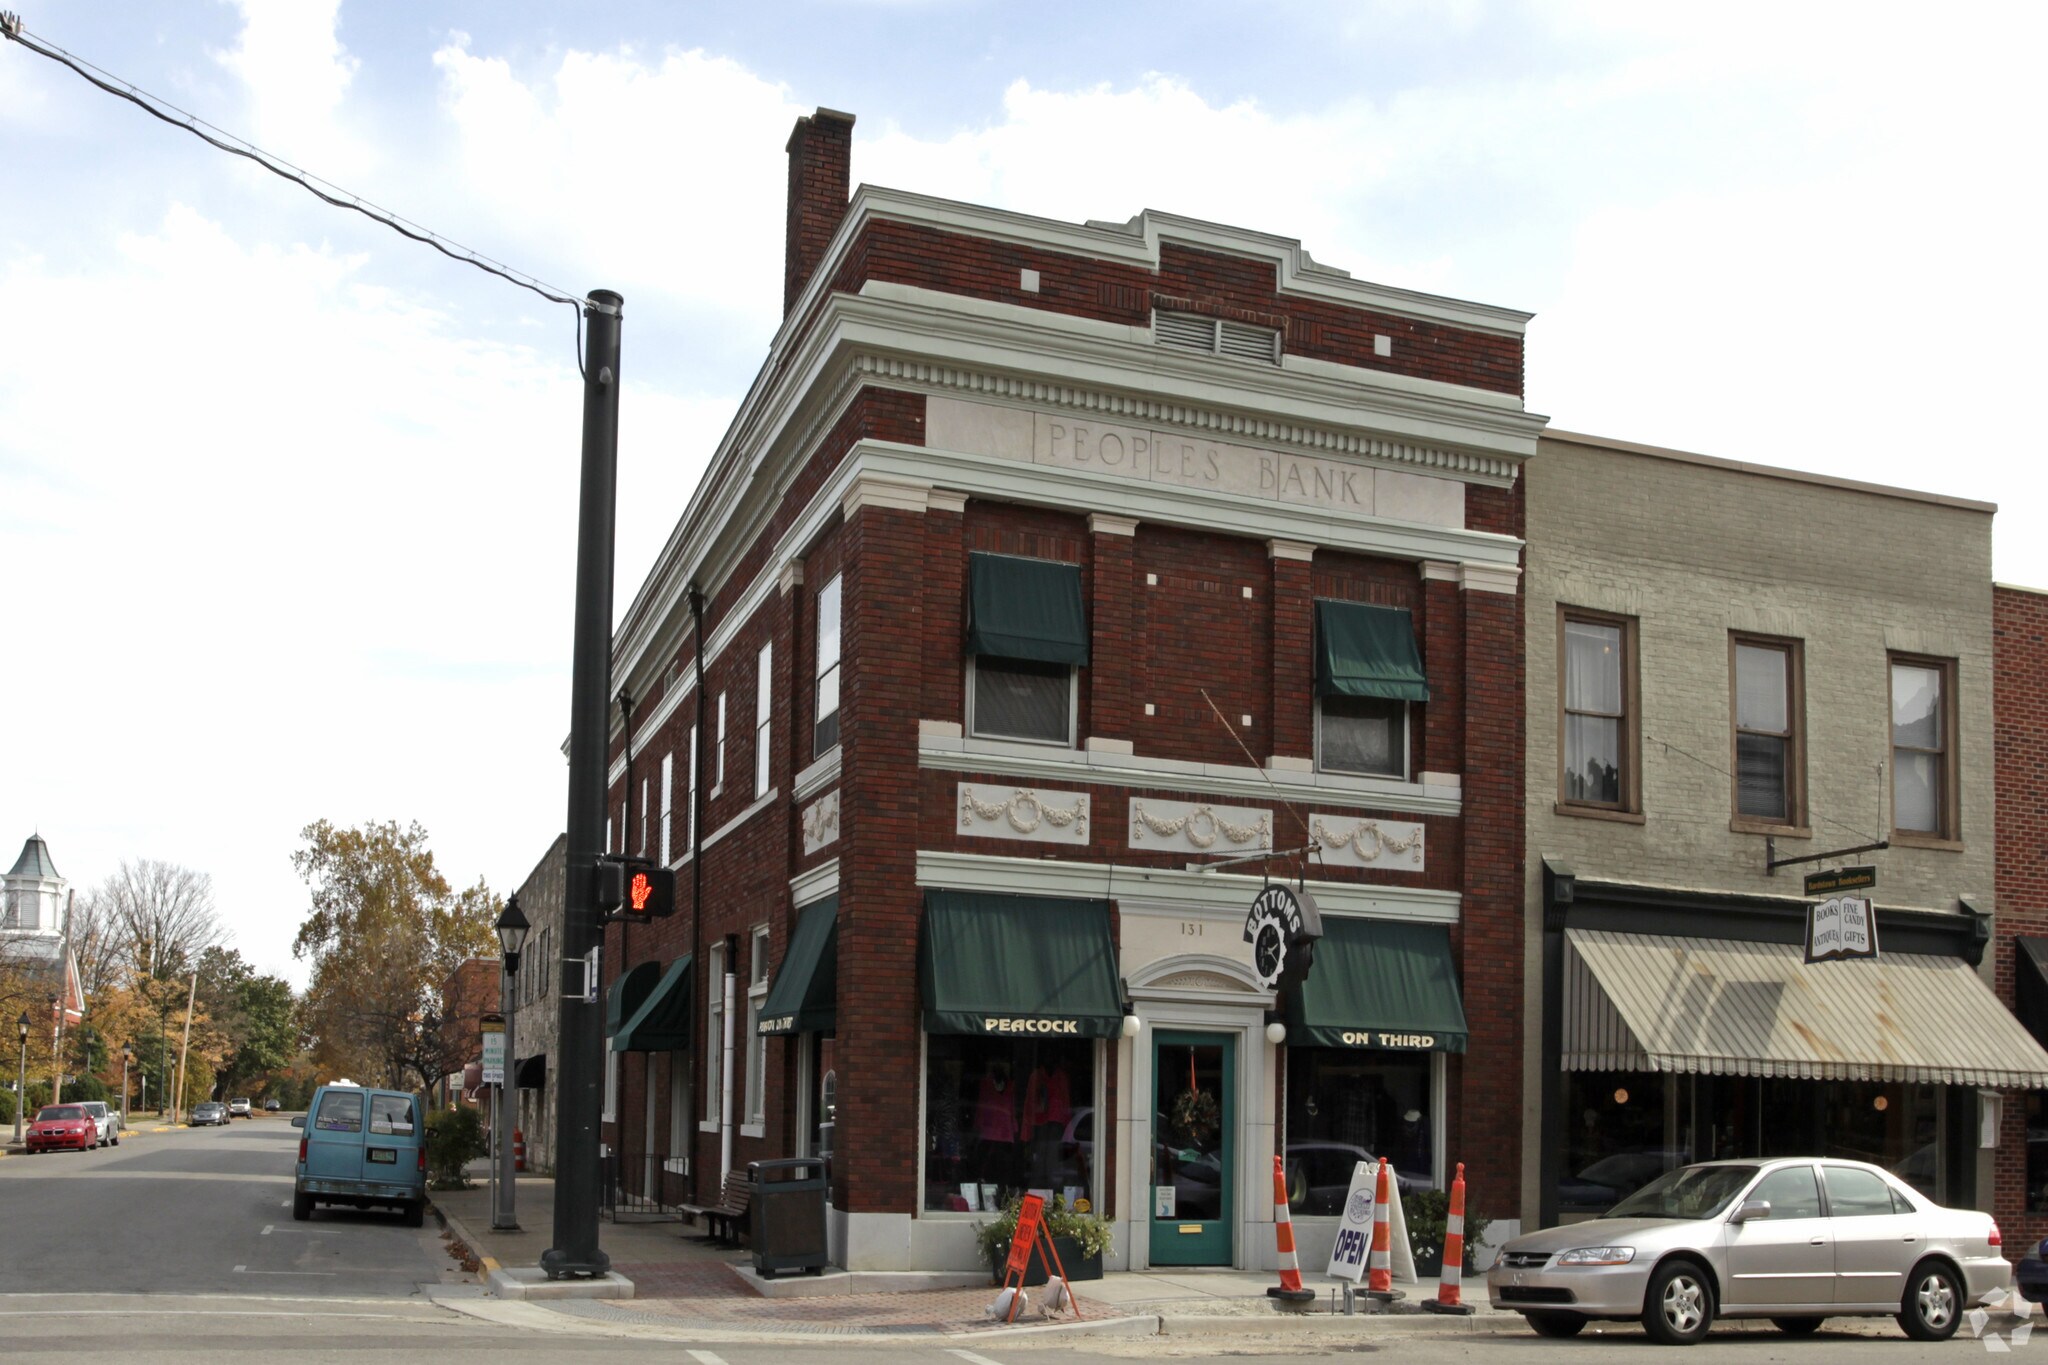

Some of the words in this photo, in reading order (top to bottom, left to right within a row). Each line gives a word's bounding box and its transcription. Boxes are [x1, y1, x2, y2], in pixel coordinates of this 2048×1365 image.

[1049, 424, 1220, 481] PEOPLES
[1260, 457, 1360, 504] BANK
[1247, 889, 1300, 934] BOTTOMS
[1816, 904, 1838, 921] BOOKS
[1843, 903, 1858, 914] FINE
[1844, 914, 1864, 926] CANDY
[1181, 922, 1203, 936] 131
[1814, 929, 1839, 946] ANTIQUES
[1844, 931, 1865, 944] GIFTS
[985, 1018, 1077, 1033] PEACOCK
[1342, 1032, 1369, 1045] ON
[1379, 1033, 1434, 1048] THIRD
[1333, 1229, 1369, 1265] OPEN
